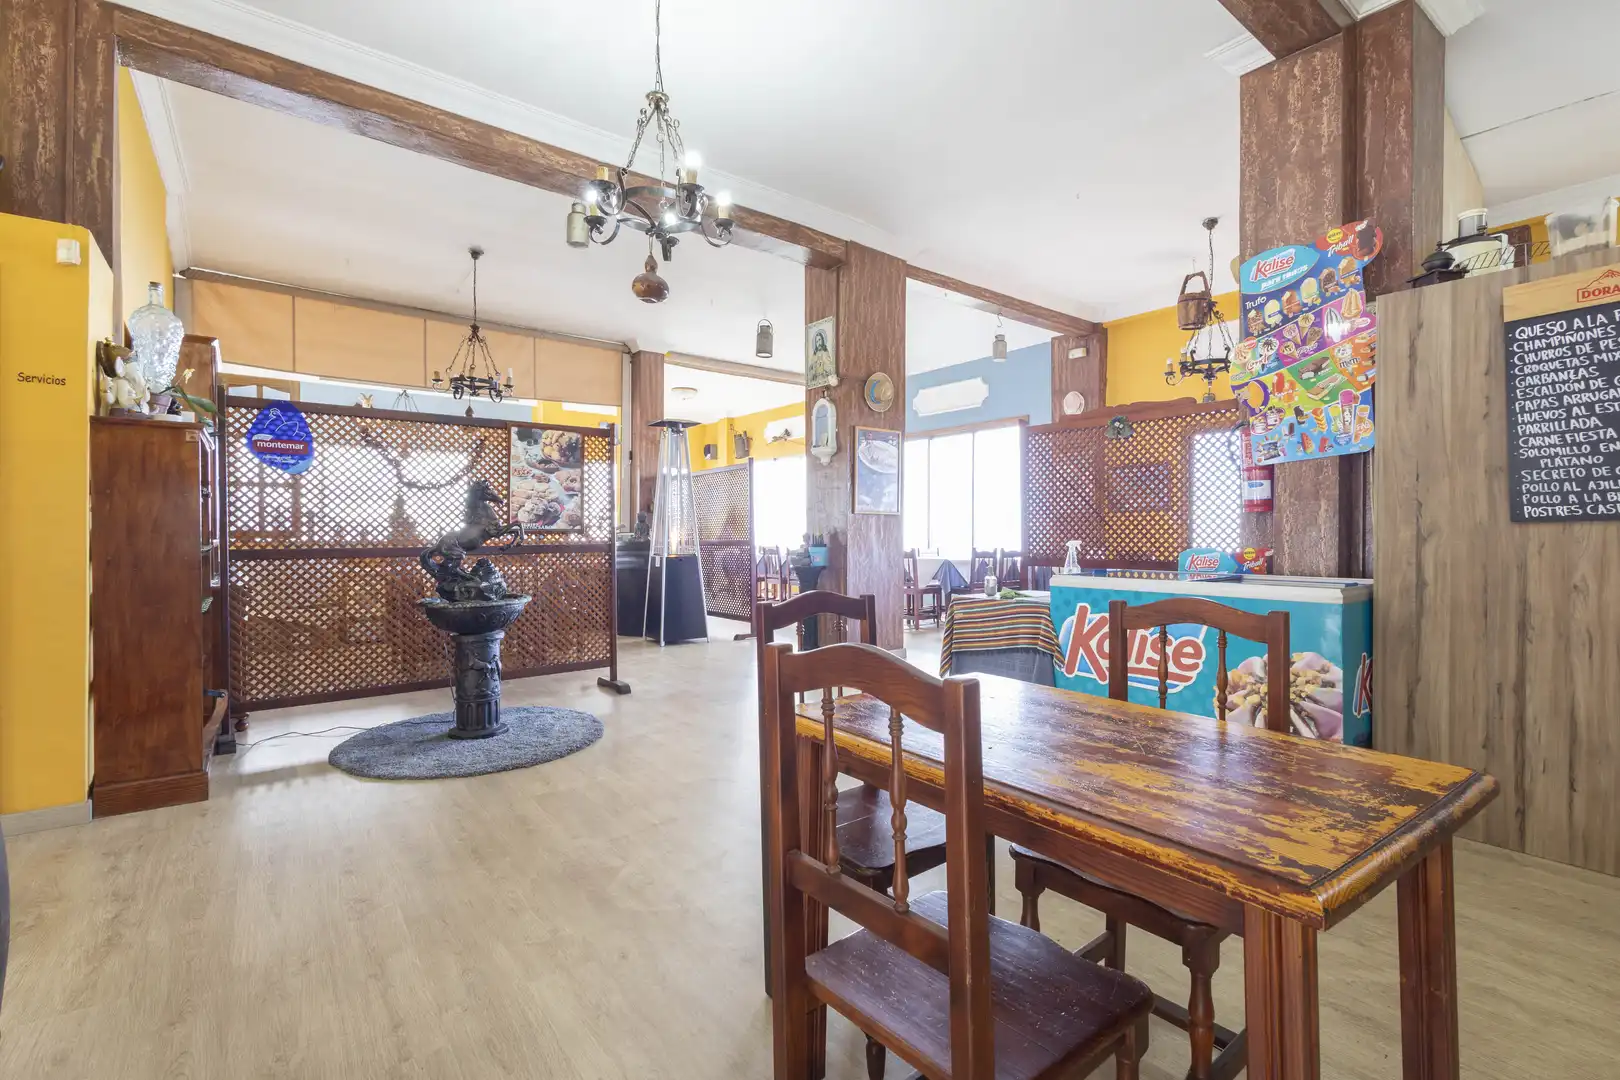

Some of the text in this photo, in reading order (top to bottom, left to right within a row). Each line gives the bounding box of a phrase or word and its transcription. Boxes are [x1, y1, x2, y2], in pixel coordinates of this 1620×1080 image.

[1253, 253, 1295, 281] Kalise
[1515, 320, 1567, 339] QUESO
[1573, 317, 1584, 330] A
[1586, 313, 1608, 328] LA
[1513, 324, 1616, 352] CHAMPIÑONES
[1513, 345, 1572, 365] CHURROS
[1575, 342, 1595, 355] DE
[1514, 355, 1590, 375] CROQUETAS
[17, 371, 67, 386] Servicios
[1515, 366, 1600, 388] GARBANZAS
[1516, 380, 1586, 399] ESCALDÓN
[1589, 377, 1609, 390] DE
[1515, 396, 1559, 413] PAPAS
[1517, 408, 1567, 423] HUEVOS
[1572, 405, 1591, 417] AL
[1517, 416, 1603, 436] PARRILLADA
[256, 441, 304, 450] montemar
[1518, 427, 1618, 448] CARNE FIESTA
[1519, 444, 1591, 459] SOLOMILLO
[1540, 455, 1604, 468] PLÁTANO
[1520, 467, 1586, 482] SECRETO
[1591, 466, 1612, 477] DE
[1521, 481, 1560, 494] POLLO
[1563, 481, 1582, 492] AL
[1522, 493, 1561, 504] POLLO
[1568, 494, 1579, 504] A
[1583, 492, 1602, 503] LA
[1523, 504, 1583, 518] POSTRES
[1187, 552, 1219, 571] Kalise
